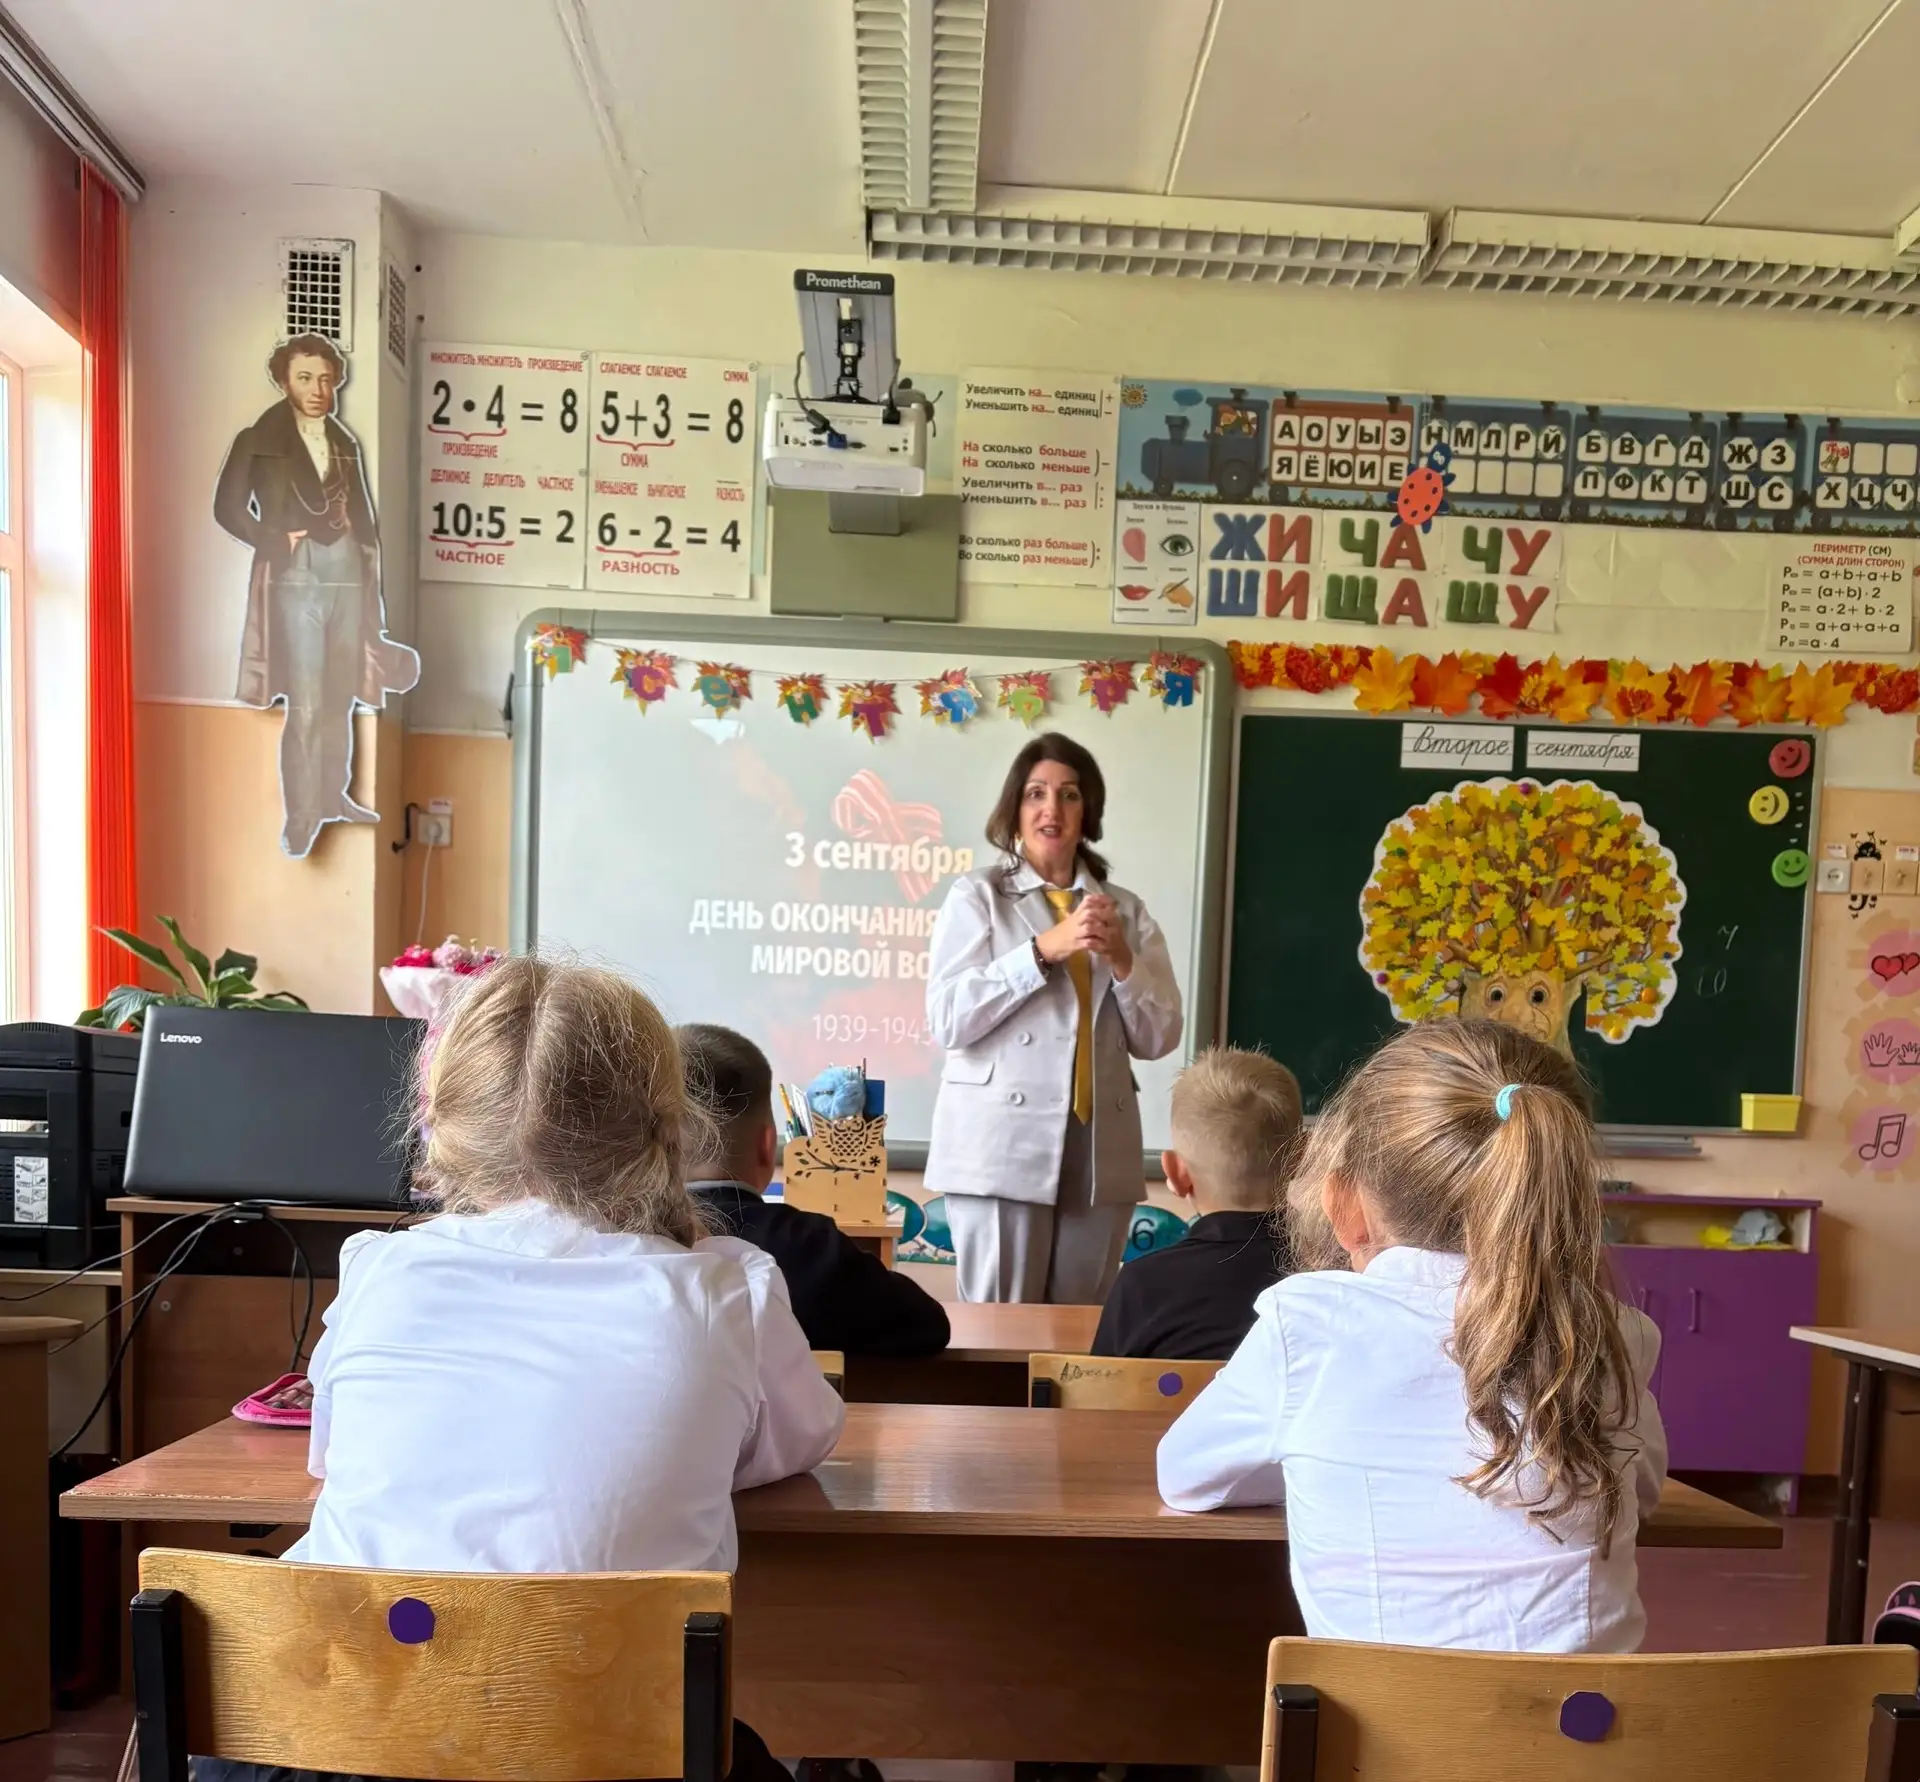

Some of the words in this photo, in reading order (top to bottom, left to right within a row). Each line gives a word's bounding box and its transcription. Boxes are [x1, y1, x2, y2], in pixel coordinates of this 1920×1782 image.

[805, 273, 881, 290] Promethean
[600, 362, 641, 375] СЛАГАЕМОЕ
[646, 366, 687, 378] СЛАГАЕМОЕ
[723, 370, 749, 382] СУММА
[966, 383, 1026, 397] Увеличить
[1054, 389, 1097, 403] единиц
[560, 388, 577, 434] 8
[965, 399, 1029, 412] Уменьшить
[1057, 405, 1099, 419] единиц
[726, 398, 744, 444] 8
[963, 441, 979, 452] На
[982, 444, 1033, 455] сколько
[1039, 445, 1087, 459] больше
[621, 453, 648, 468] СУММА
[962, 457, 979, 468] На
[985, 459, 1035, 470] сколько
[1041, 463, 1091, 474] меньше
[430, 469, 470, 484] ДЕЛИМОЕ
[483, 473, 525, 488] ДЕЛИТЕЛЬ
[537, 476, 574, 492] ЧАСТНОЕ
[962, 477, 1033, 491] Увеличить
[1060, 484, 1083, 494] раз
[961, 492, 1037, 507] Уменьшить
[1064, 499, 1087, 509] раз
[556, 510, 574, 543] 2
[721, 520, 741, 552] 4
[976, 536, 1021, 548] сколько
[1023, 539, 1042, 549] раз
[1045, 539, 1088, 552] больше
[435, 549, 506, 566] ЧАСТНОЕ
[975, 551, 1020, 563] сколько
[1023, 554, 1042, 565] раз
[1045, 556, 1088, 566] меньше
[1813, 543, 1866, 554] ПЕРИМЕТР
[1868, 545, 1892, 556] (СМ)
[602, 560, 680, 576] РАЗНОСТЬ
[1798, 556, 1834, 565] (СУММА
[1836, 557, 1862, 567] ДЛИН
[1865, 558, 1904, 569] СТОРОН)
[1413, 725, 1509, 766] Второе
[1535, 734, 1635, 768] сентября
[785, 832, 806, 867] 3
[813, 835, 974, 883] сентября
[688, 898, 764, 935] ДЕНЬ
[770, 901, 939, 938] ОКОНЧАНИЯ
[751, 940, 890, 979] МИРОВОЙ
[160, 1032, 202, 1045] Lenovo
